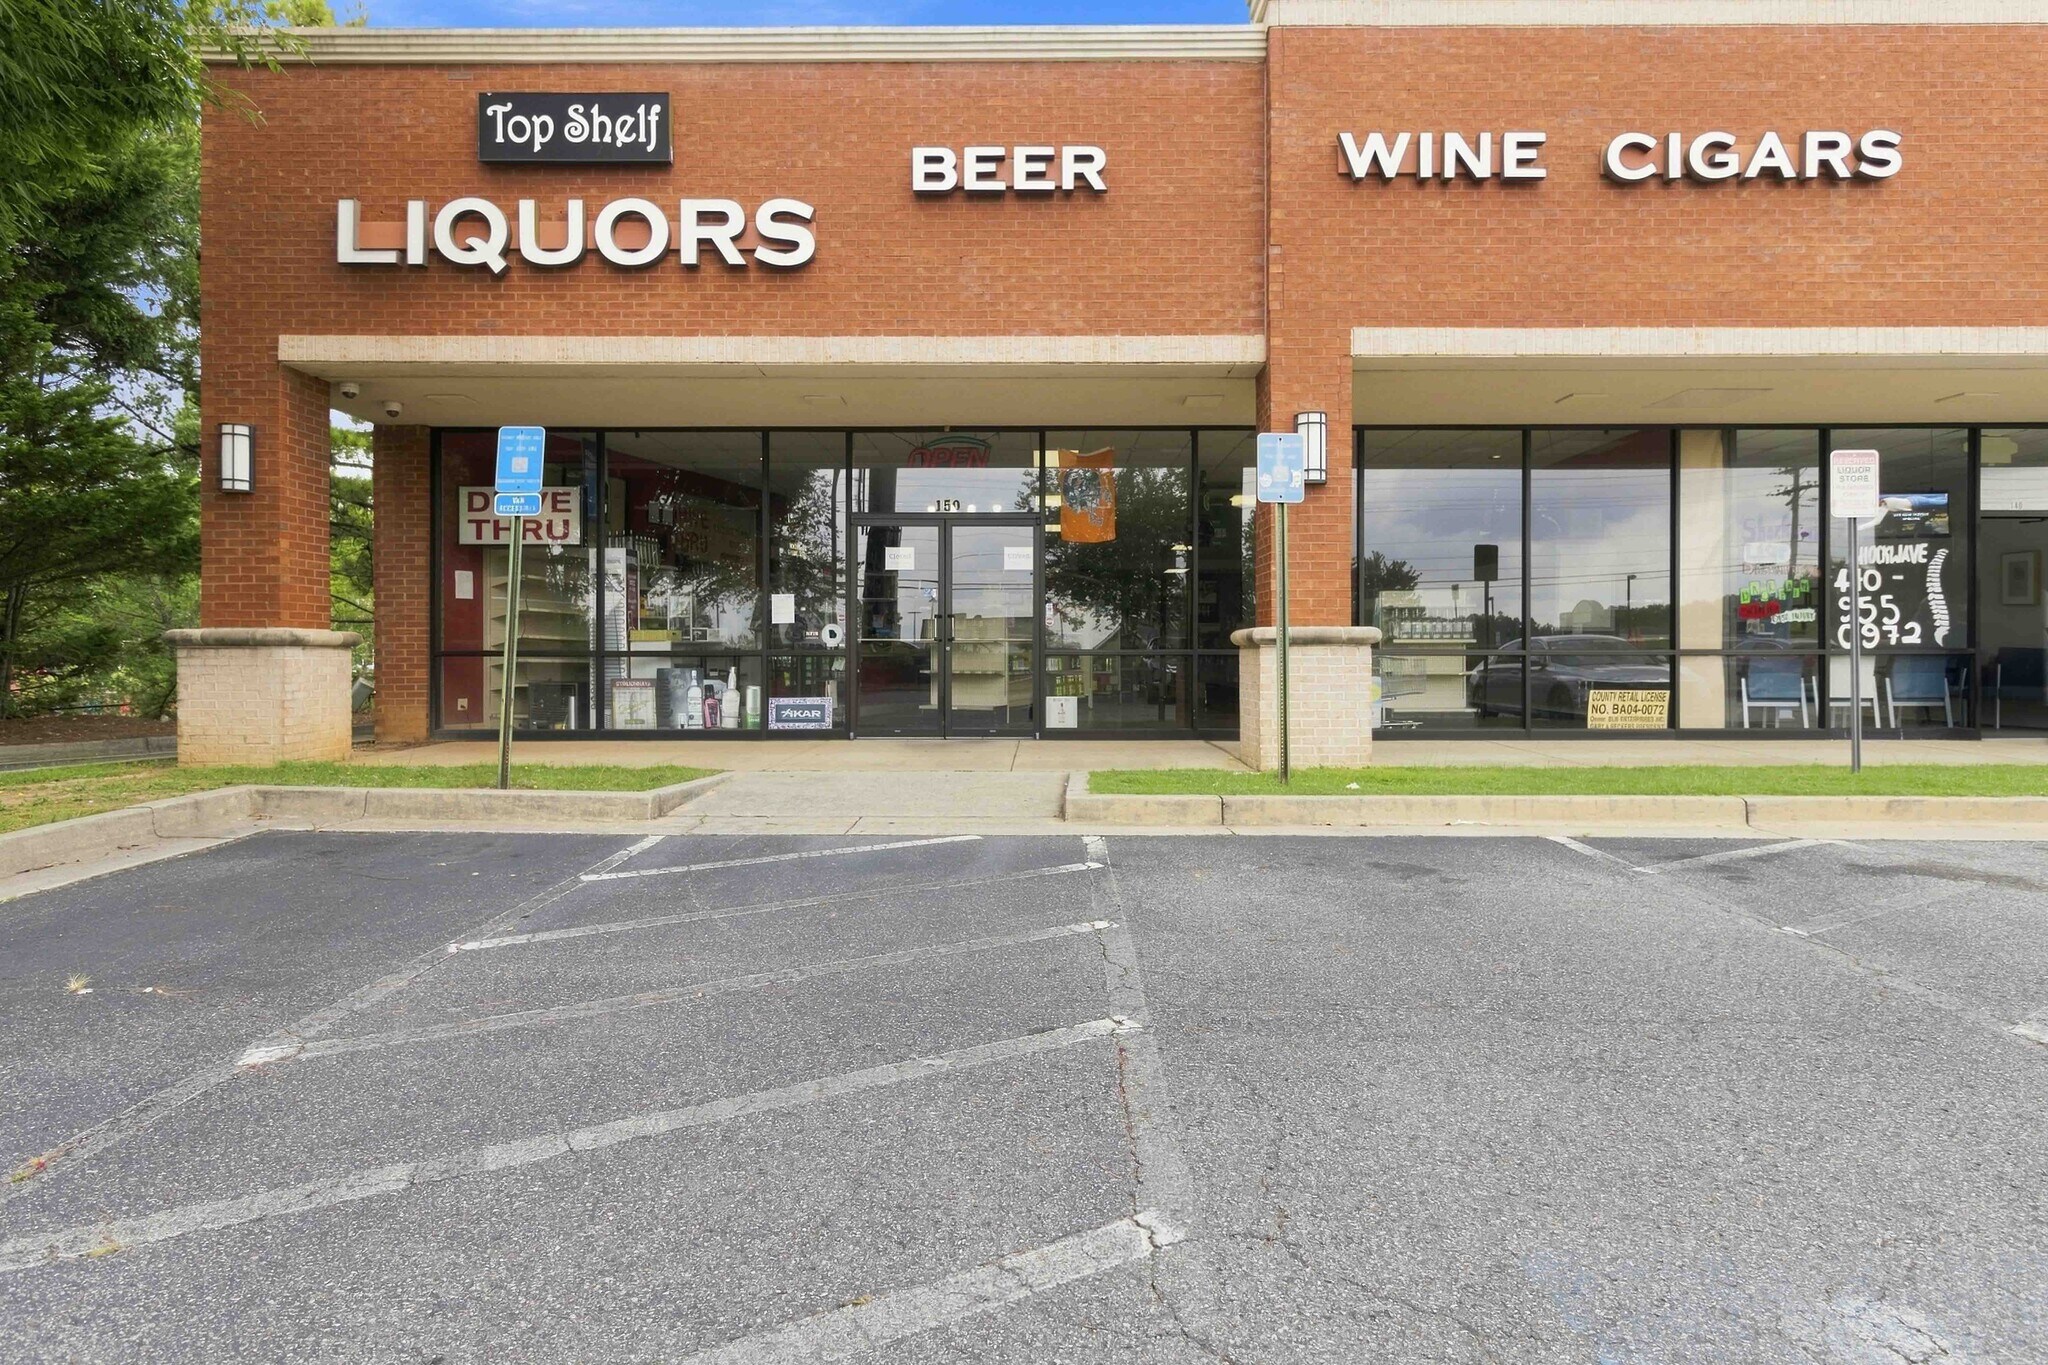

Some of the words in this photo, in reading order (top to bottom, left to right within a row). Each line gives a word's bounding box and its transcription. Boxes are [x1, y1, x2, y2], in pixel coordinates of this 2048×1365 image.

[486, 103, 554, 152] Top
[564, 104, 661, 151] Shelf
[1337, 131, 1547, 181] WINE
[1605, 129, 1904, 183] CIGARS
[911, 145, 1108, 193] BEER
[337, 197, 817, 275] LIQUORS
[1837, 466, 1871, 474] LIQUOR
[936, 500, 961, 511] 150
[467, 519, 570, 541] THRU
[1858, 543, 1929, 565] HOCKWAVE
[1591, 691, 1616, 702] COUNTY
[1617, 691, 1639, 702] RETAIL
[1641, 691, 1667, 702] LICENSE
[1591, 704, 1608, 715] NO.
[1612, 704, 1665, 715] BA04-0072
